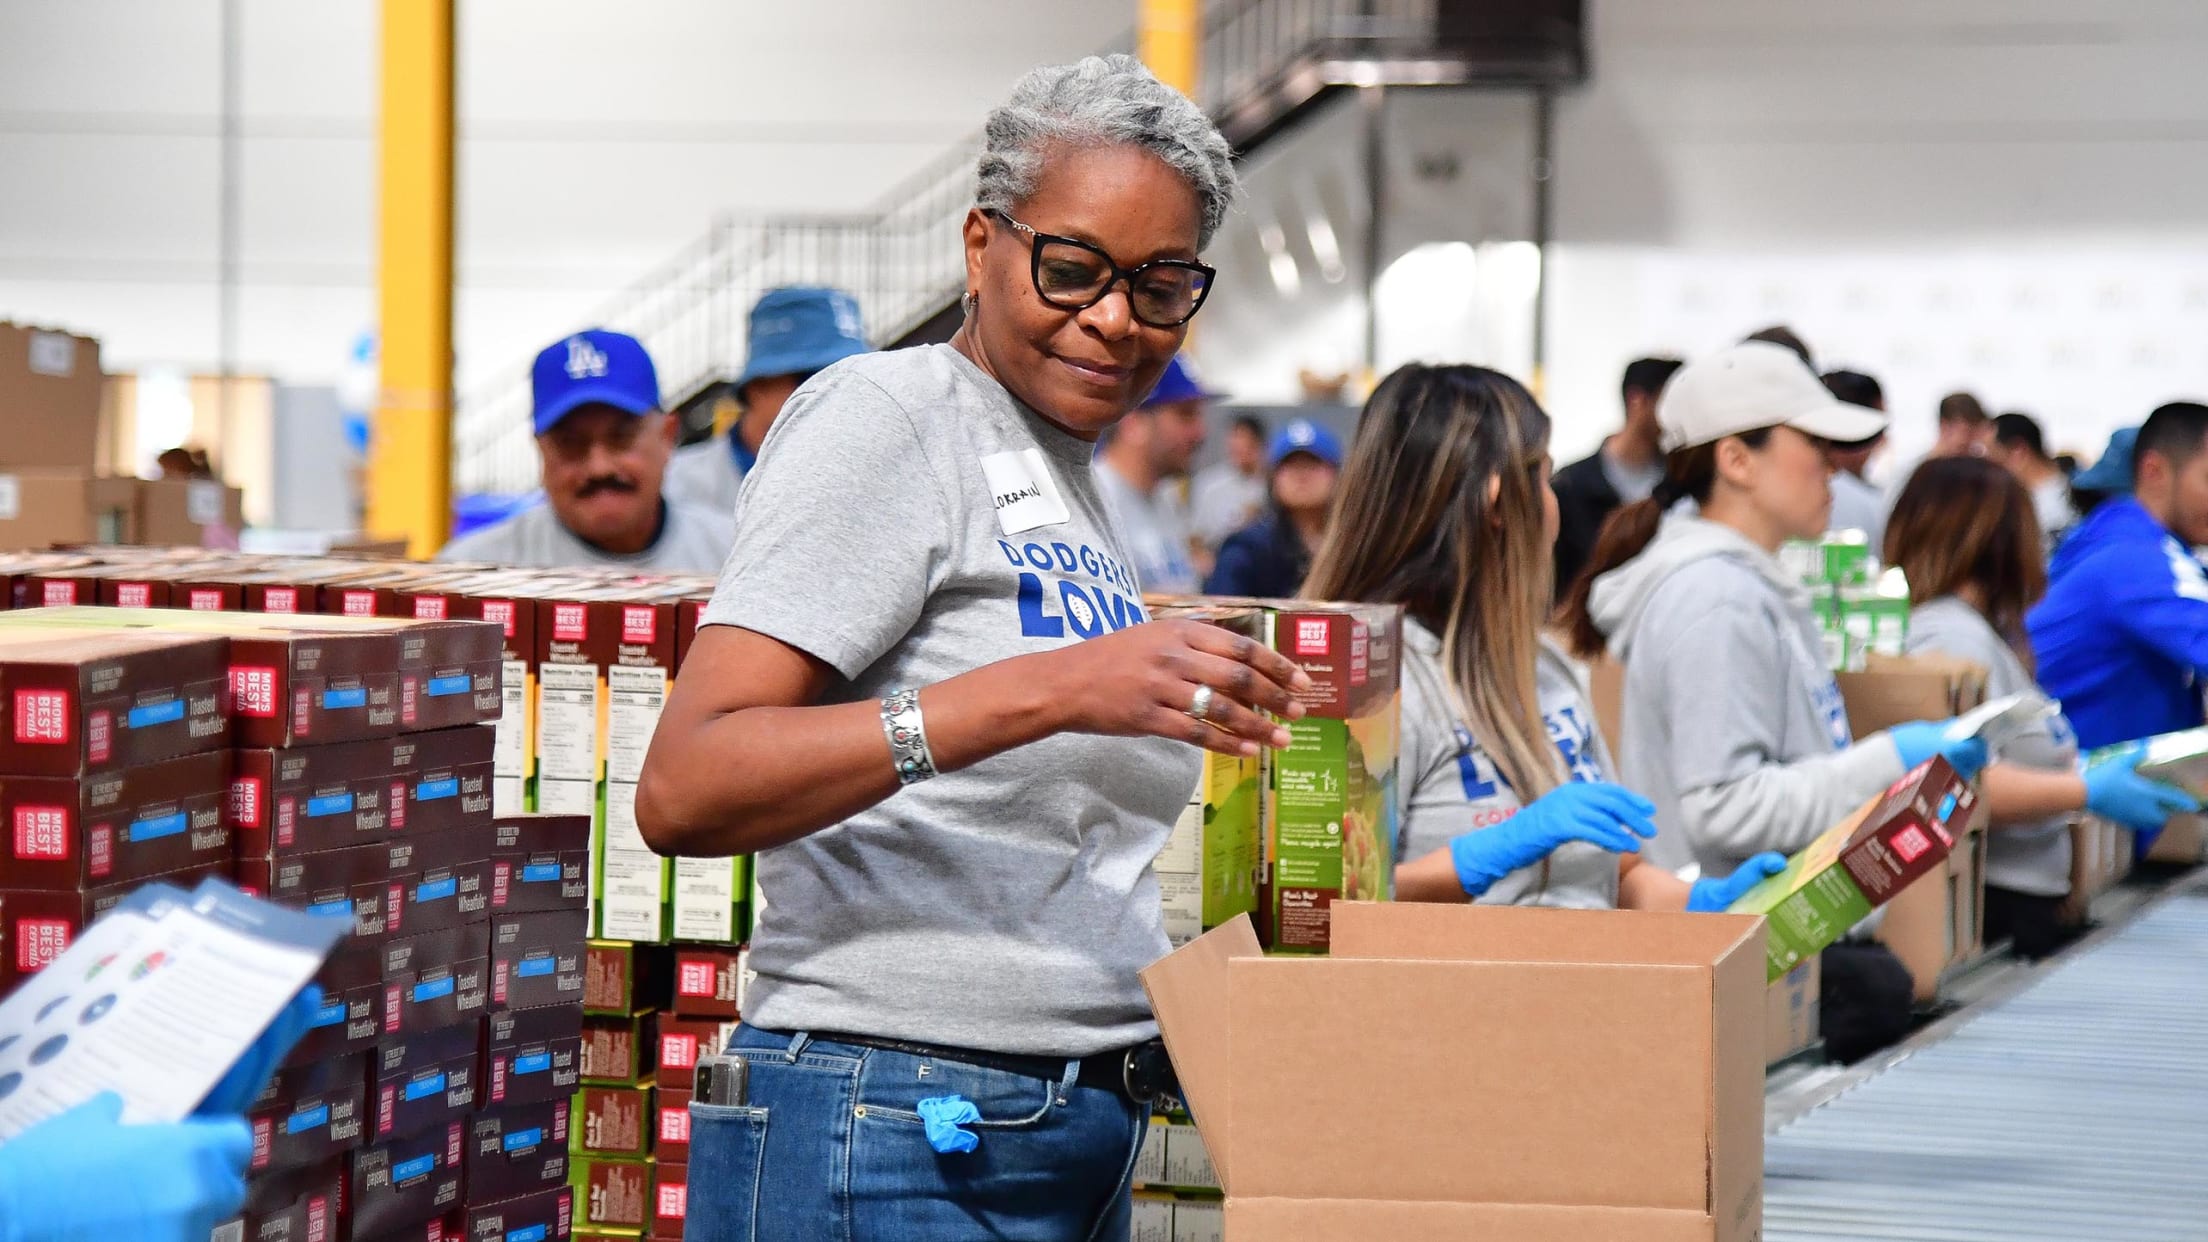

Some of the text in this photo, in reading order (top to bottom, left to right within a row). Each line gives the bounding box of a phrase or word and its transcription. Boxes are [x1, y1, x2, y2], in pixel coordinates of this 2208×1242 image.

[997, 539, 1133, 597] DODGERS
[555, 616, 583, 625] BEST
[624, 618, 652, 627] BEST
[1299, 631, 1327, 640] BEST
[235, 671, 246, 712] cereals
[247, 671, 260, 712] BEST
[474, 672, 494, 691] Toasted
[260, 671, 272, 713] MOM'S
[369, 686, 389, 705] Toasted
[189, 694, 216, 716] Toasted
[26, 696, 36, 738] cereals
[37, 696, 50, 739] BEST
[51, 696, 62, 739] MOM'S
[462, 775, 483, 794] Toasted
[231, 782, 244, 822] BEST
[243, 782, 254, 824] MOM'S
[356, 790, 378, 810] Toasted
[192, 807, 219, 829] Toasted
[26, 812, 36, 854] cereals
[38, 812, 50, 854] BEST
[51, 812, 62, 855] MOM'S
[563, 863, 580, 880] Toasted
[459, 874, 480, 893] Toasted
[356, 896, 378, 915] Toasted
[558, 956, 576, 972] Toasted
[458, 973, 478, 992] Toasted
[350, 1000, 371, 1020] Toasted
[553, 1050, 572, 1068] Toasted
[448, 1068, 468, 1088] Toasted
[331, 1100, 353, 1119] Toasted
